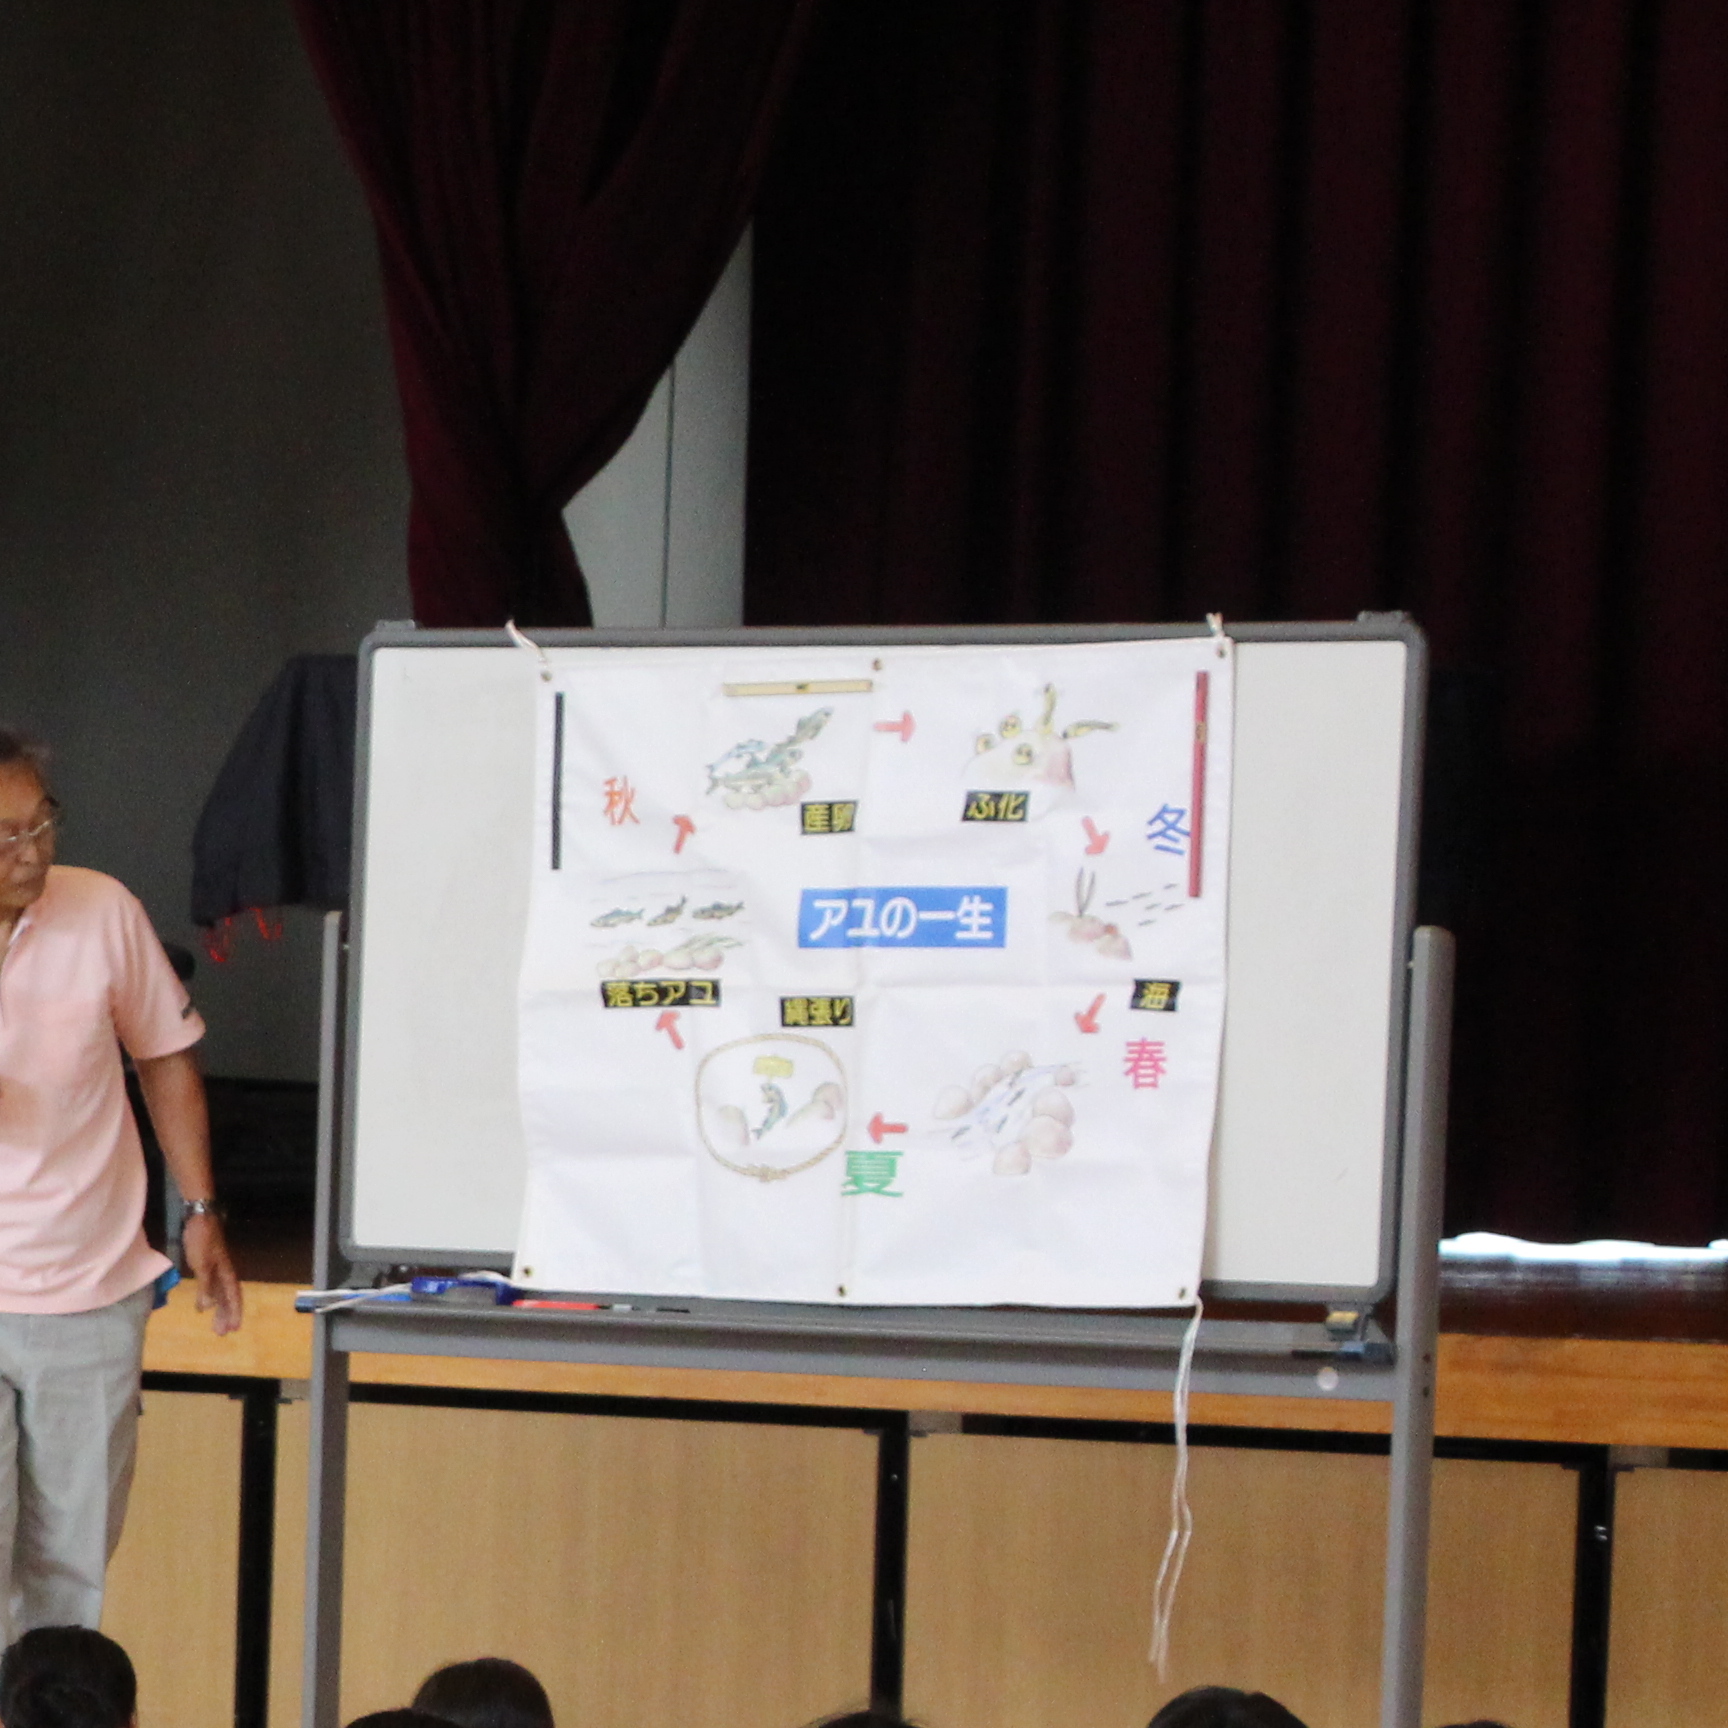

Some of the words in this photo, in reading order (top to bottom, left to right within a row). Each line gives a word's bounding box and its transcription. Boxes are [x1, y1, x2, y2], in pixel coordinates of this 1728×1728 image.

[604, 775, 640, 826] 秋
[804, 804, 855, 831] 産卵
[966, 793, 1026, 819] ふ化
[1147, 803, 1192, 855] 冬
[809, 896, 993, 941] アユの一生
[606, 980, 716, 1007] 落ちアユ
[1124, 1038, 1167, 1089] 春
[841, 1150, 904, 1197] 夏
